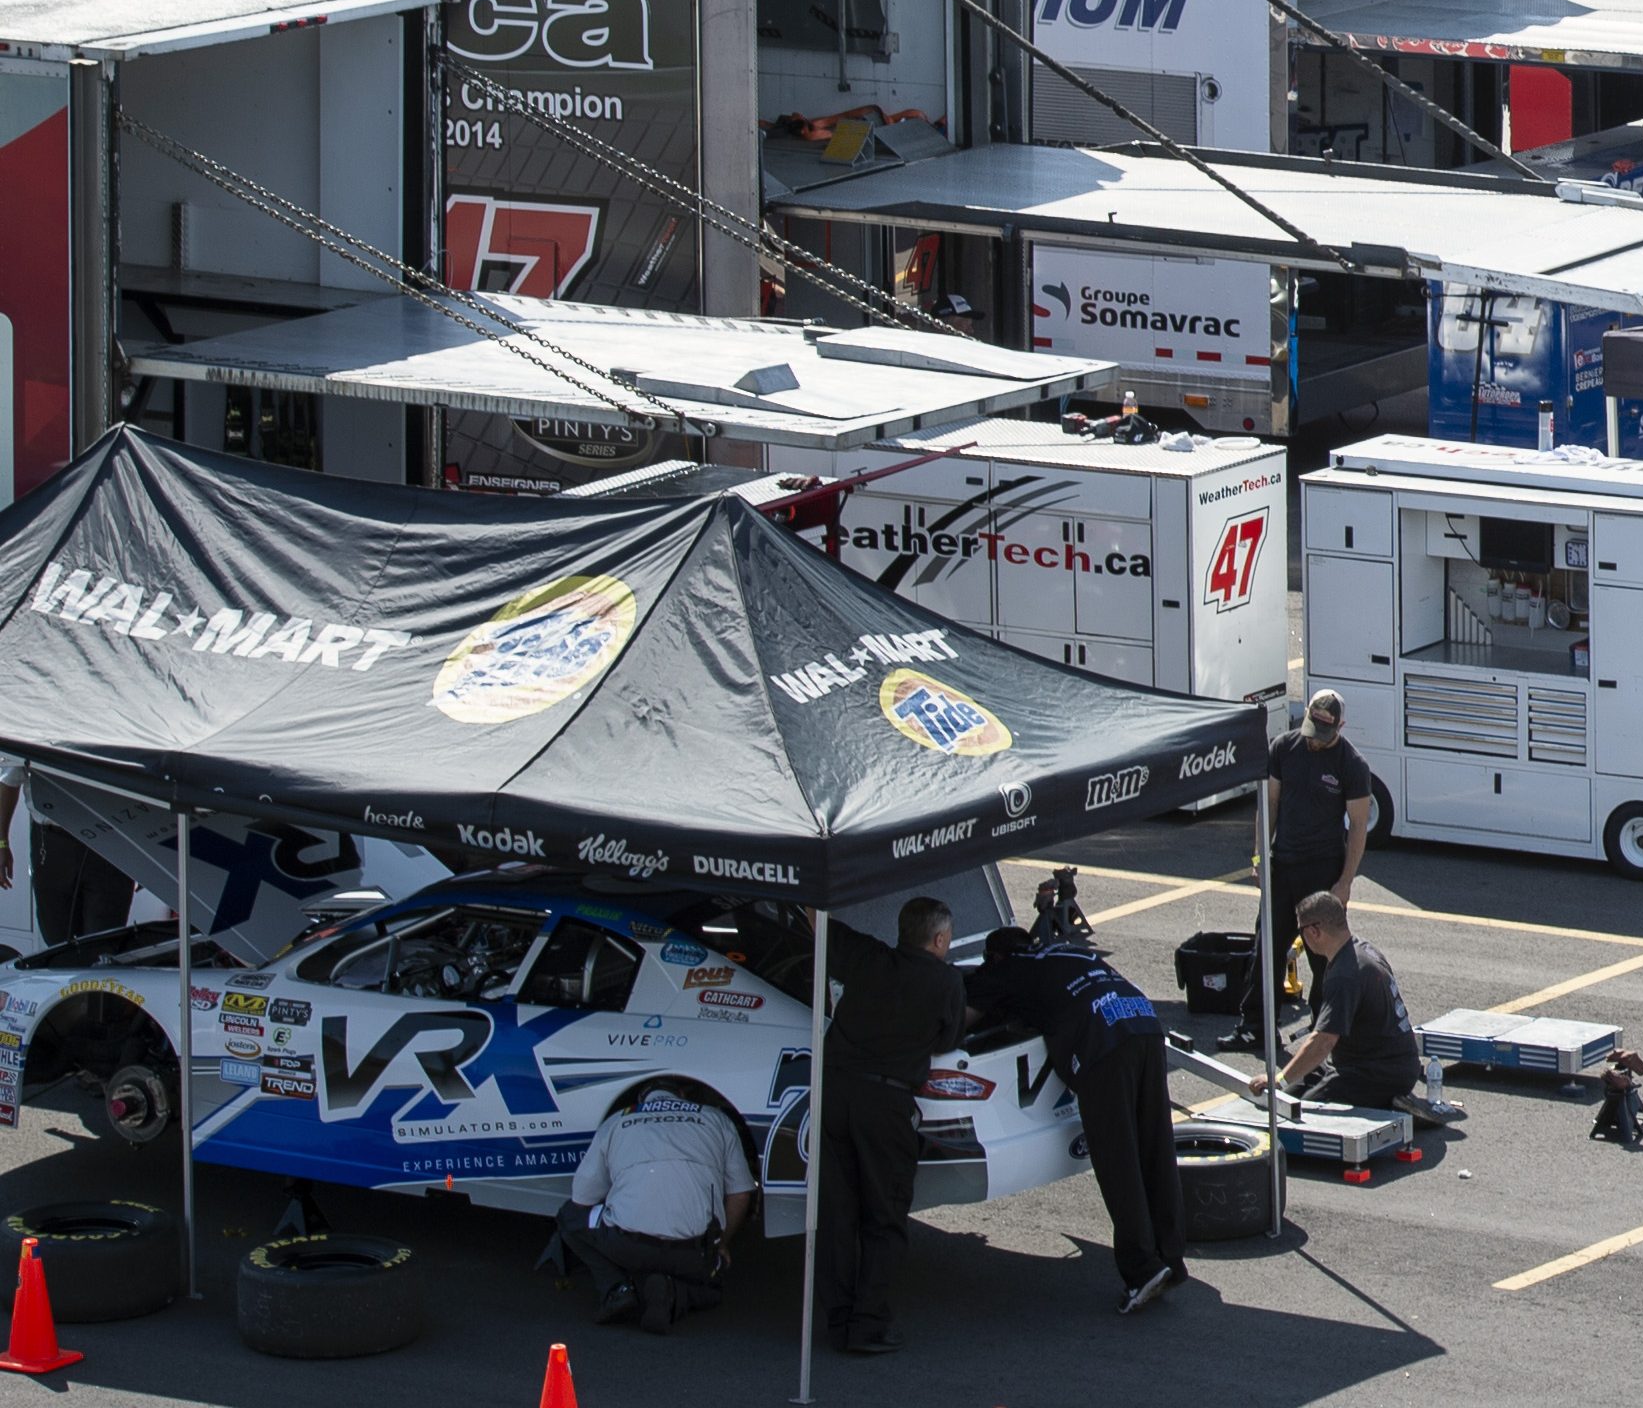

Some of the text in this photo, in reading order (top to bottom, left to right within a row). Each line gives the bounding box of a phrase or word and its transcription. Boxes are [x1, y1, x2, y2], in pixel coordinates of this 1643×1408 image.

[460, 83, 624, 123] Champion
[1080, 286, 1151, 308] Groupe
[1080, 302, 1241, 339] Somavrac
[1199, 471, 1281, 506] WeatherTech.ca
[1210, 512, 1268, 606] 47
[894, 686, 986, 749] Tide
[1179, 740, 1238, 780] Kodak
[364, 804, 425, 831] head&
[991, 814, 1037, 839] UBISOFT
[456, 822, 548, 858] Kodak
[578, 833, 671, 879] Kellogg's
[693, 853, 799, 885] DURACELL
[702, 992, 760, 1008] CATHCART
[219, 1015, 258, 1027] LINCOLN
[273, 1006, 309, 1020] PINTY'S
[226, 1025, 263, 1037] WELDERS
[223, 1065, 260, 1081] LELAND
[279, 1059, 301, 1069] FDP
[266, 1077, 313, 1095] TREND
[642, 1100, 700, 1114] NASCAR
[396, 1119, 564, 1138] SIMULATORS.com
[621, 1113, 706, 1129] OFFICIAL
[402, 1154, 508, 1173] EXPERIENCE
